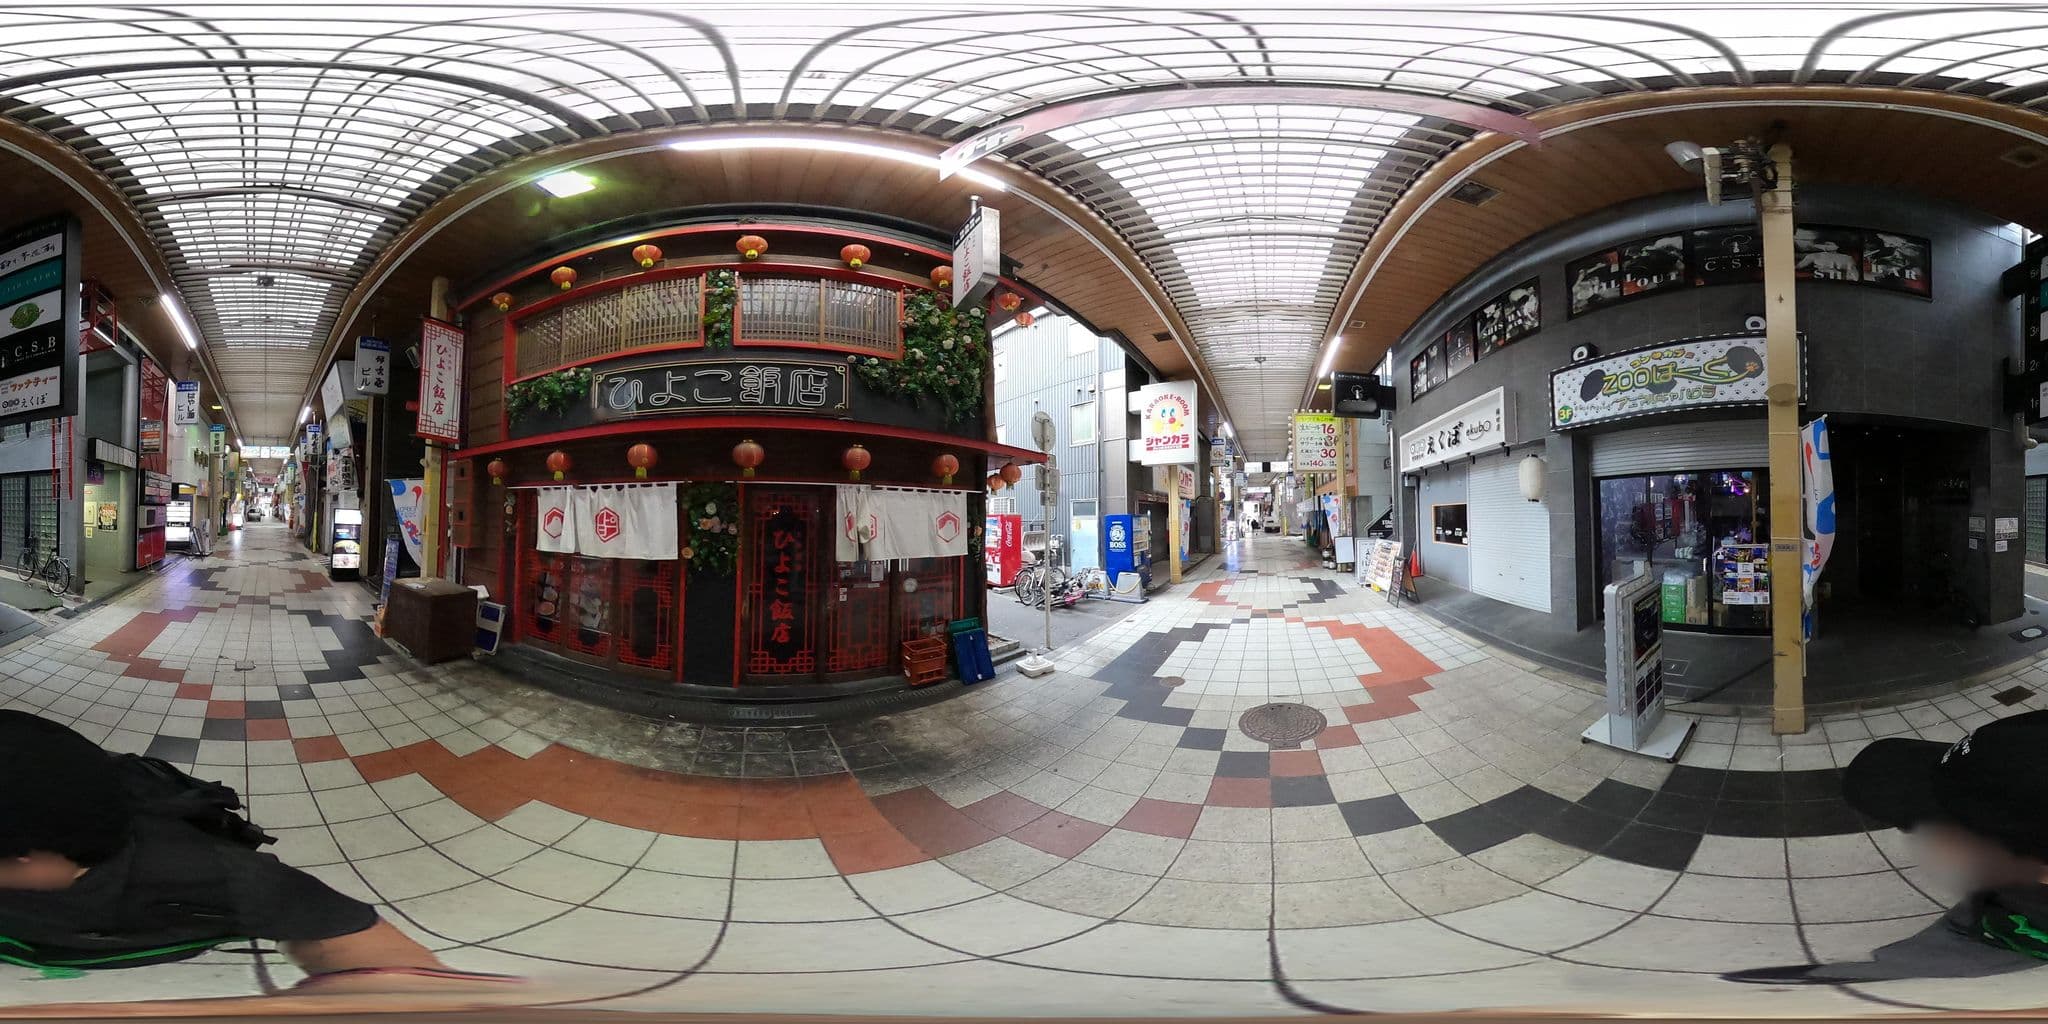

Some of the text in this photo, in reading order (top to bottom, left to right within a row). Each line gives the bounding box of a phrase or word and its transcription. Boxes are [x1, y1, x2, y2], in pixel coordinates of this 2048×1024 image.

[433, 344, 448, 415] ひよこ飯店
[610, 364, 829, 410] ひよこ飯店
[21, 393, 48, 409] えくぼ
[1559, 409, 1572, 420] 3F
[1427, 421, 1465, 456] えくぼ
[1466, 420, 1492, 438] ekubo
[1109, 541, 1127, 549] BOSS
[769, 530, 794, 644] ひよこ飯店
